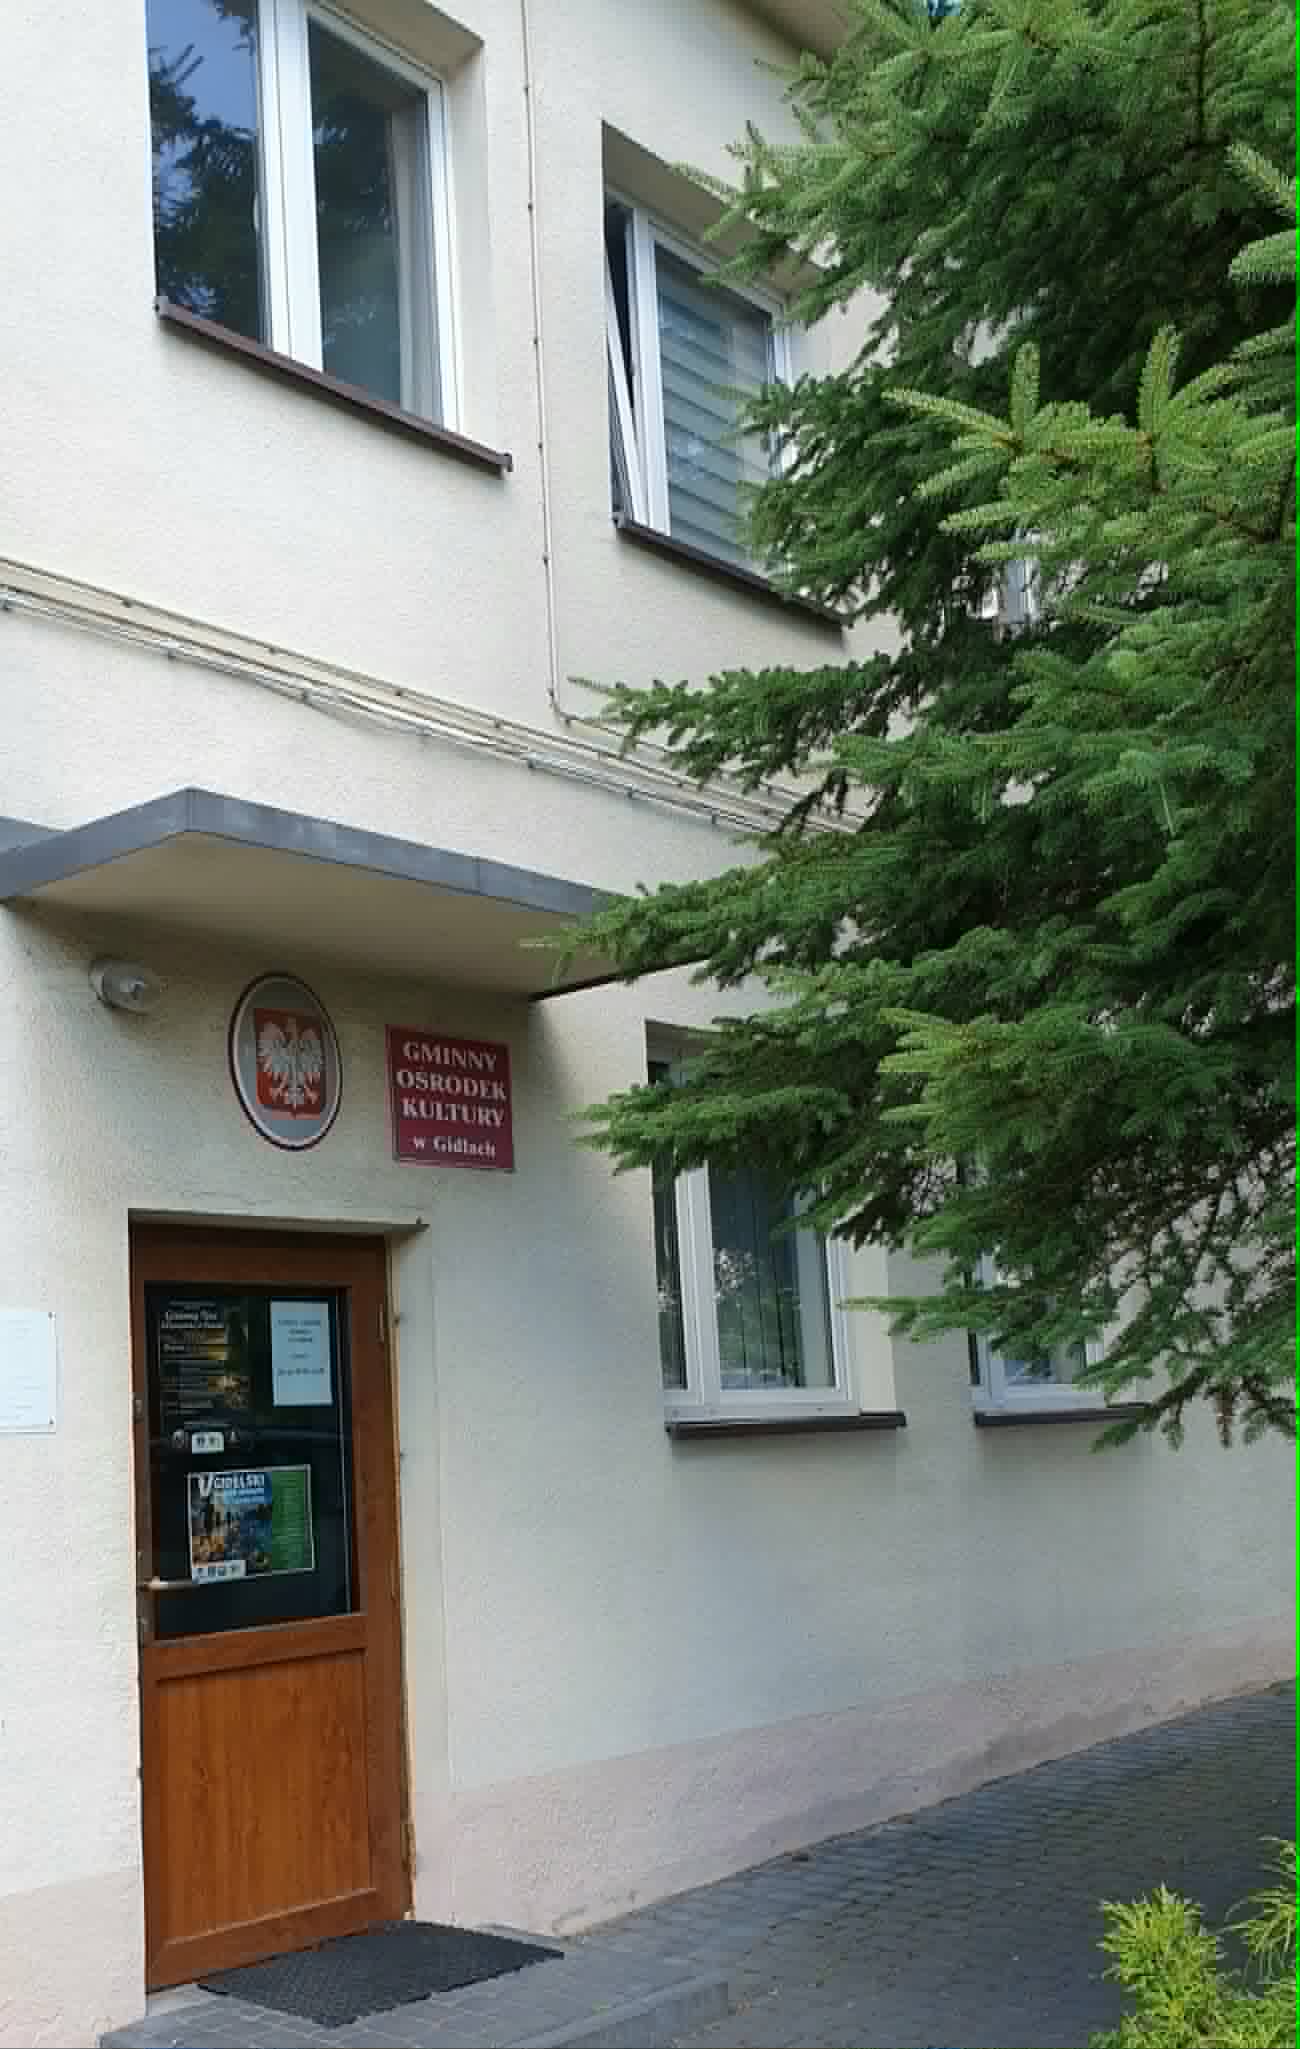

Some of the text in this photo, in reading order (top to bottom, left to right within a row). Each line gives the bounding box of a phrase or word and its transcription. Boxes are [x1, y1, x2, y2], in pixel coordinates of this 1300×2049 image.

[403, 1041, 497, 1072] GMINNY
[396, 1064, 507, 1101] OŚRODEK
[402, 1098, 504, 1128] KULTURY
[412, 1136, 496, 1159] w Gidlach
